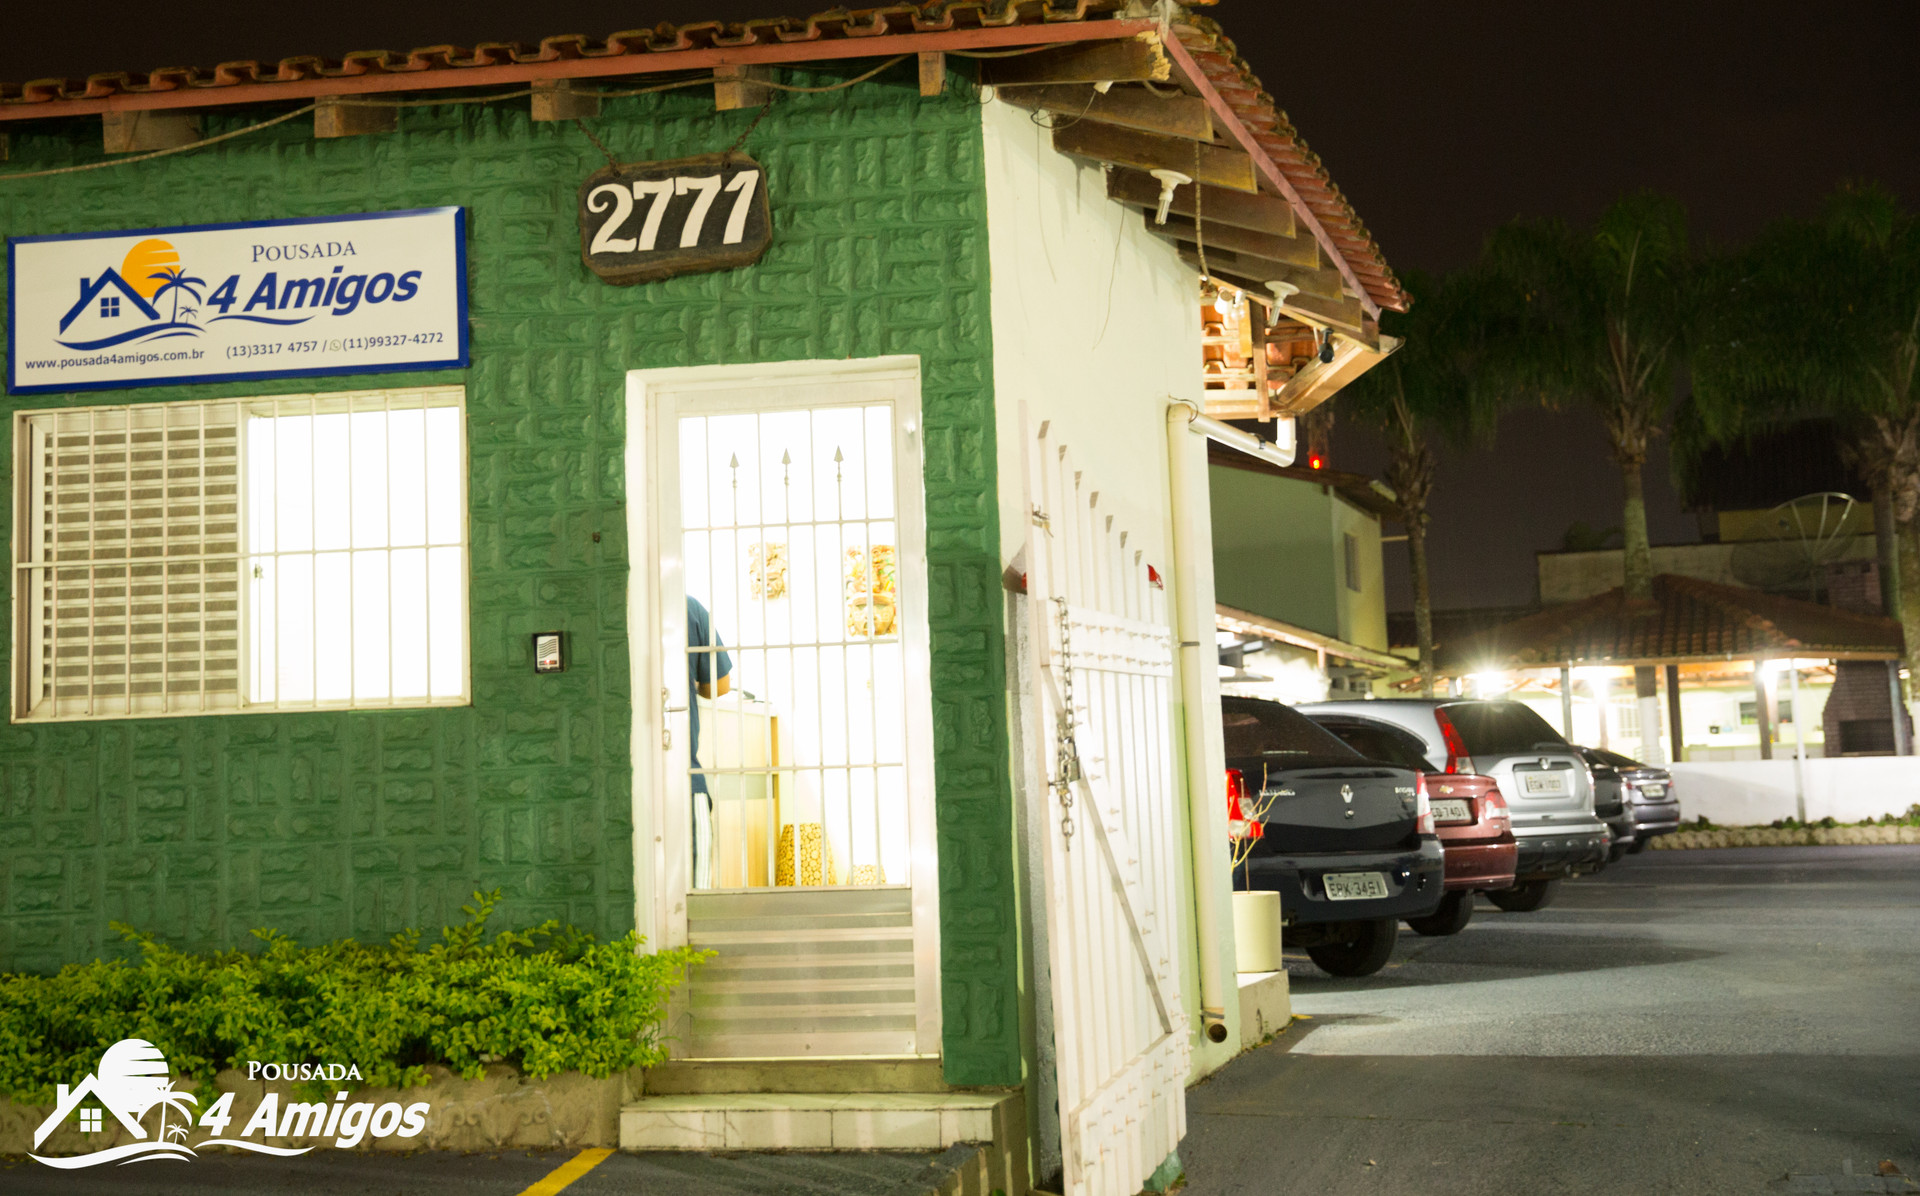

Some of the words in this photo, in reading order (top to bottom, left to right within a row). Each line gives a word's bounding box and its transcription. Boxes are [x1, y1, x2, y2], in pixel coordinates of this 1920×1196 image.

[587, 169, 759, 256] 2771
[206, 274, 241, 314] 4
[242, 265, 423, 316] Amigos
[25, 349, 205, 370] www.pousada4amigos.com.br
[226, 343, 282, 359] (13)3317
[287, 340, 318, 353] 4757
[342, 332, 444, 351] (11)99327-4272
